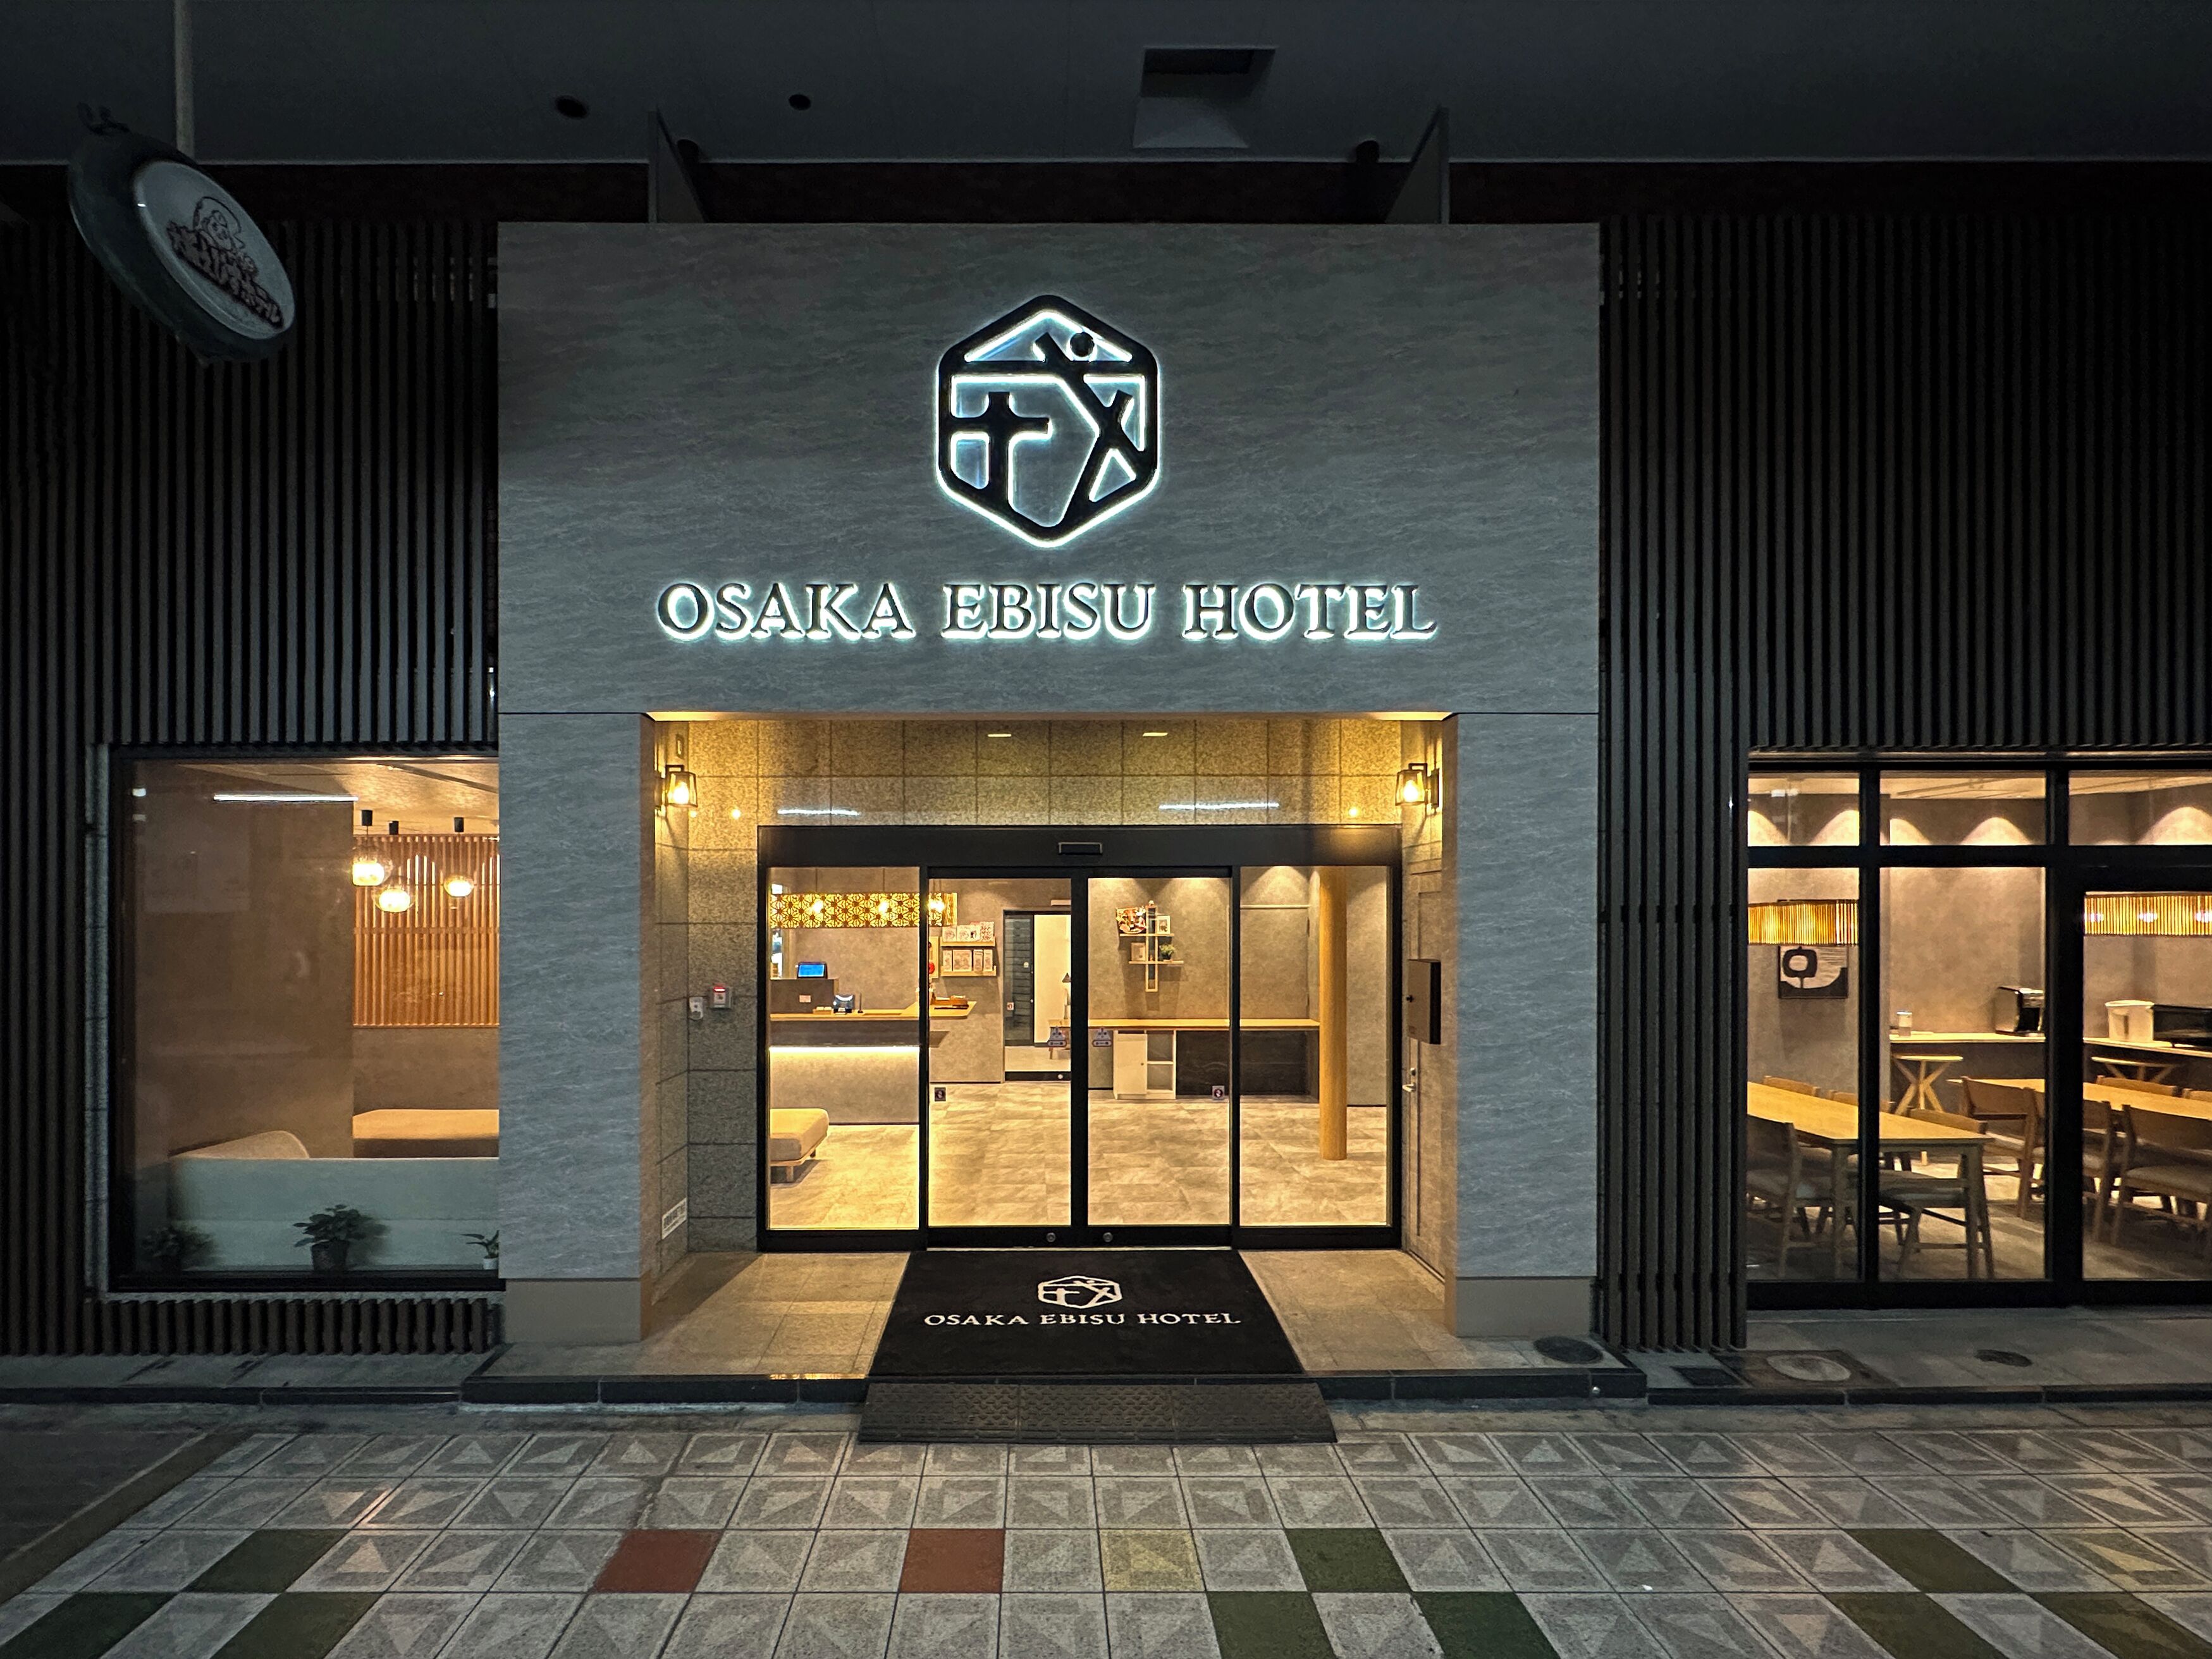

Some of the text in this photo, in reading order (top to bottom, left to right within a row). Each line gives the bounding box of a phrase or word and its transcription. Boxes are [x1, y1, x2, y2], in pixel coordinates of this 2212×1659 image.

[657, 581, 1439, 641] OSAKA EBISU HOTEL
[924, 1312, 1241, 1326] OSAKA EBISU HOTEL
